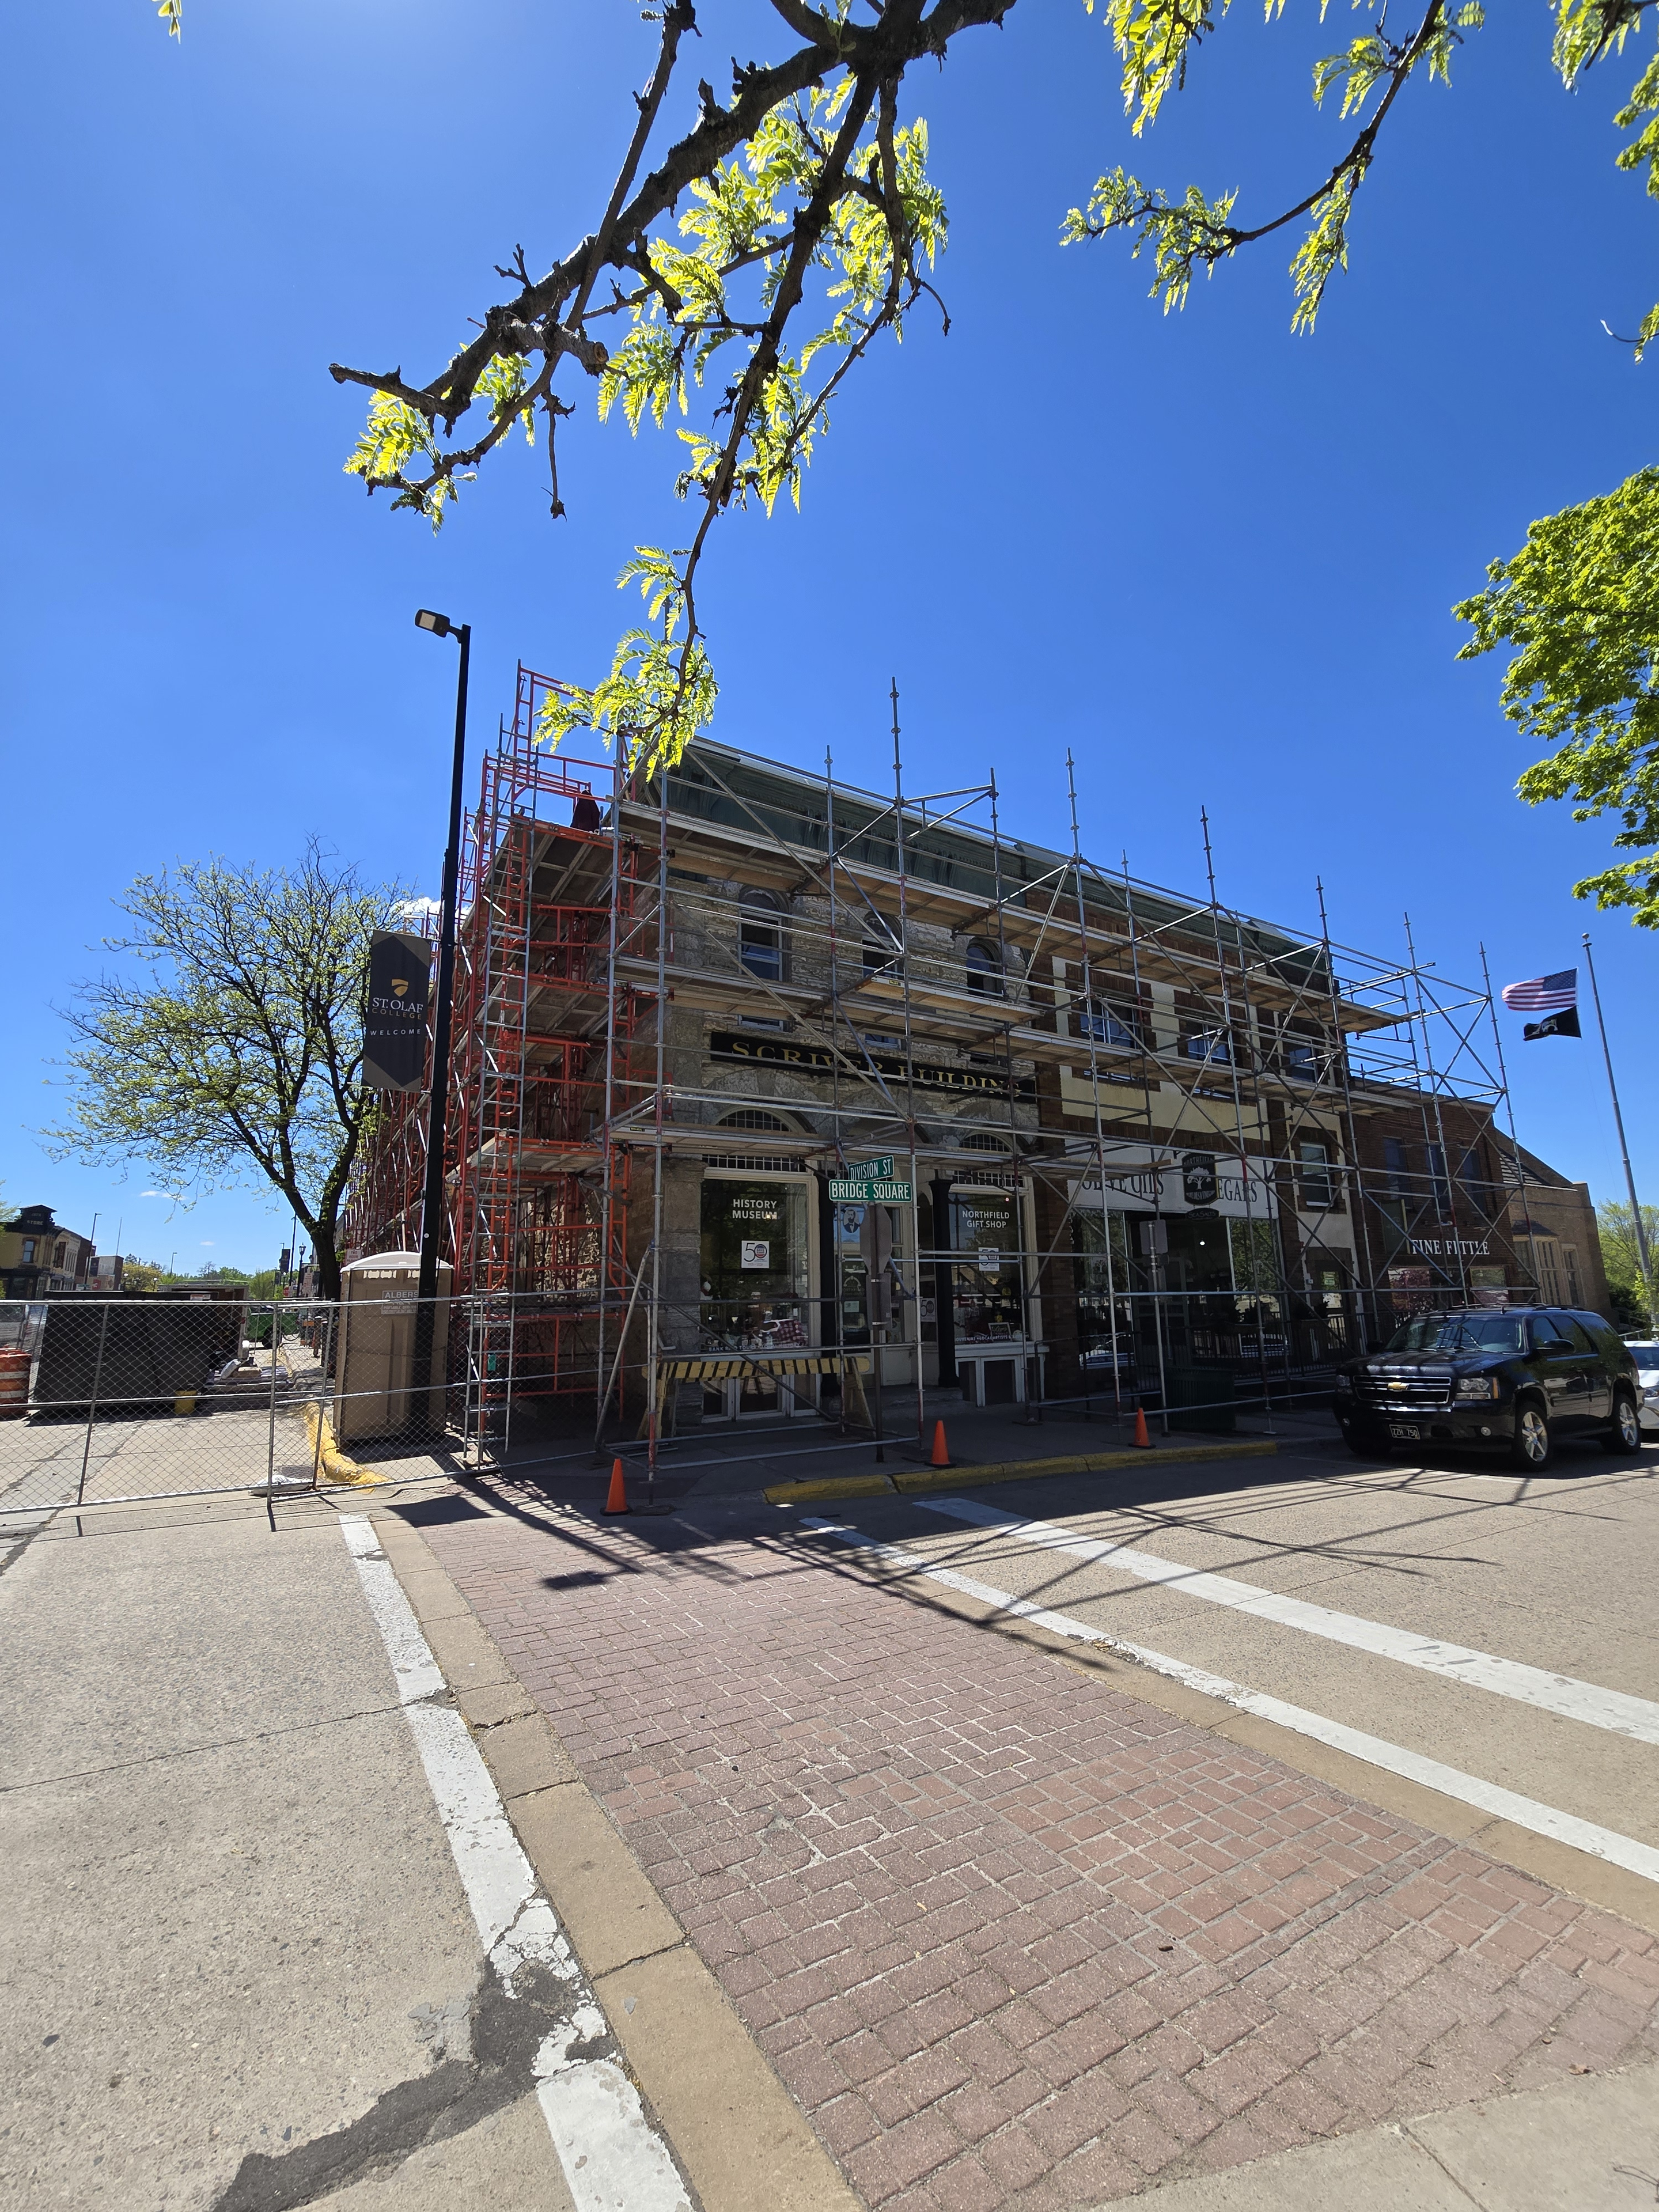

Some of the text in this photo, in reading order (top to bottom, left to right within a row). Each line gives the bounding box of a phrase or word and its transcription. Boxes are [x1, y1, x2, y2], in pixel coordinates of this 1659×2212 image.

[372, 997, 423, 1013] ST. OLAF
[372, 1007, 422, 1020] COLLEGE
[850, 1159, 891, 1180] DIVISION ST
[832, 1183, 910, 1199] BRIDGE SQUARE
[1218, 1179, 1257, 1202] EGAS
[733, 1199, 777, 1209] HISTORY
[732, 1210, 778, 1220] MUSEUM
[962, 1210, 1010, 1219] NORTHFIELD
[967, 1220, 984, 1228] GIFT
[1411, 1239, 1442, 1255] FINE
[1392, 1428, 1418, 1437] ZZH 750
